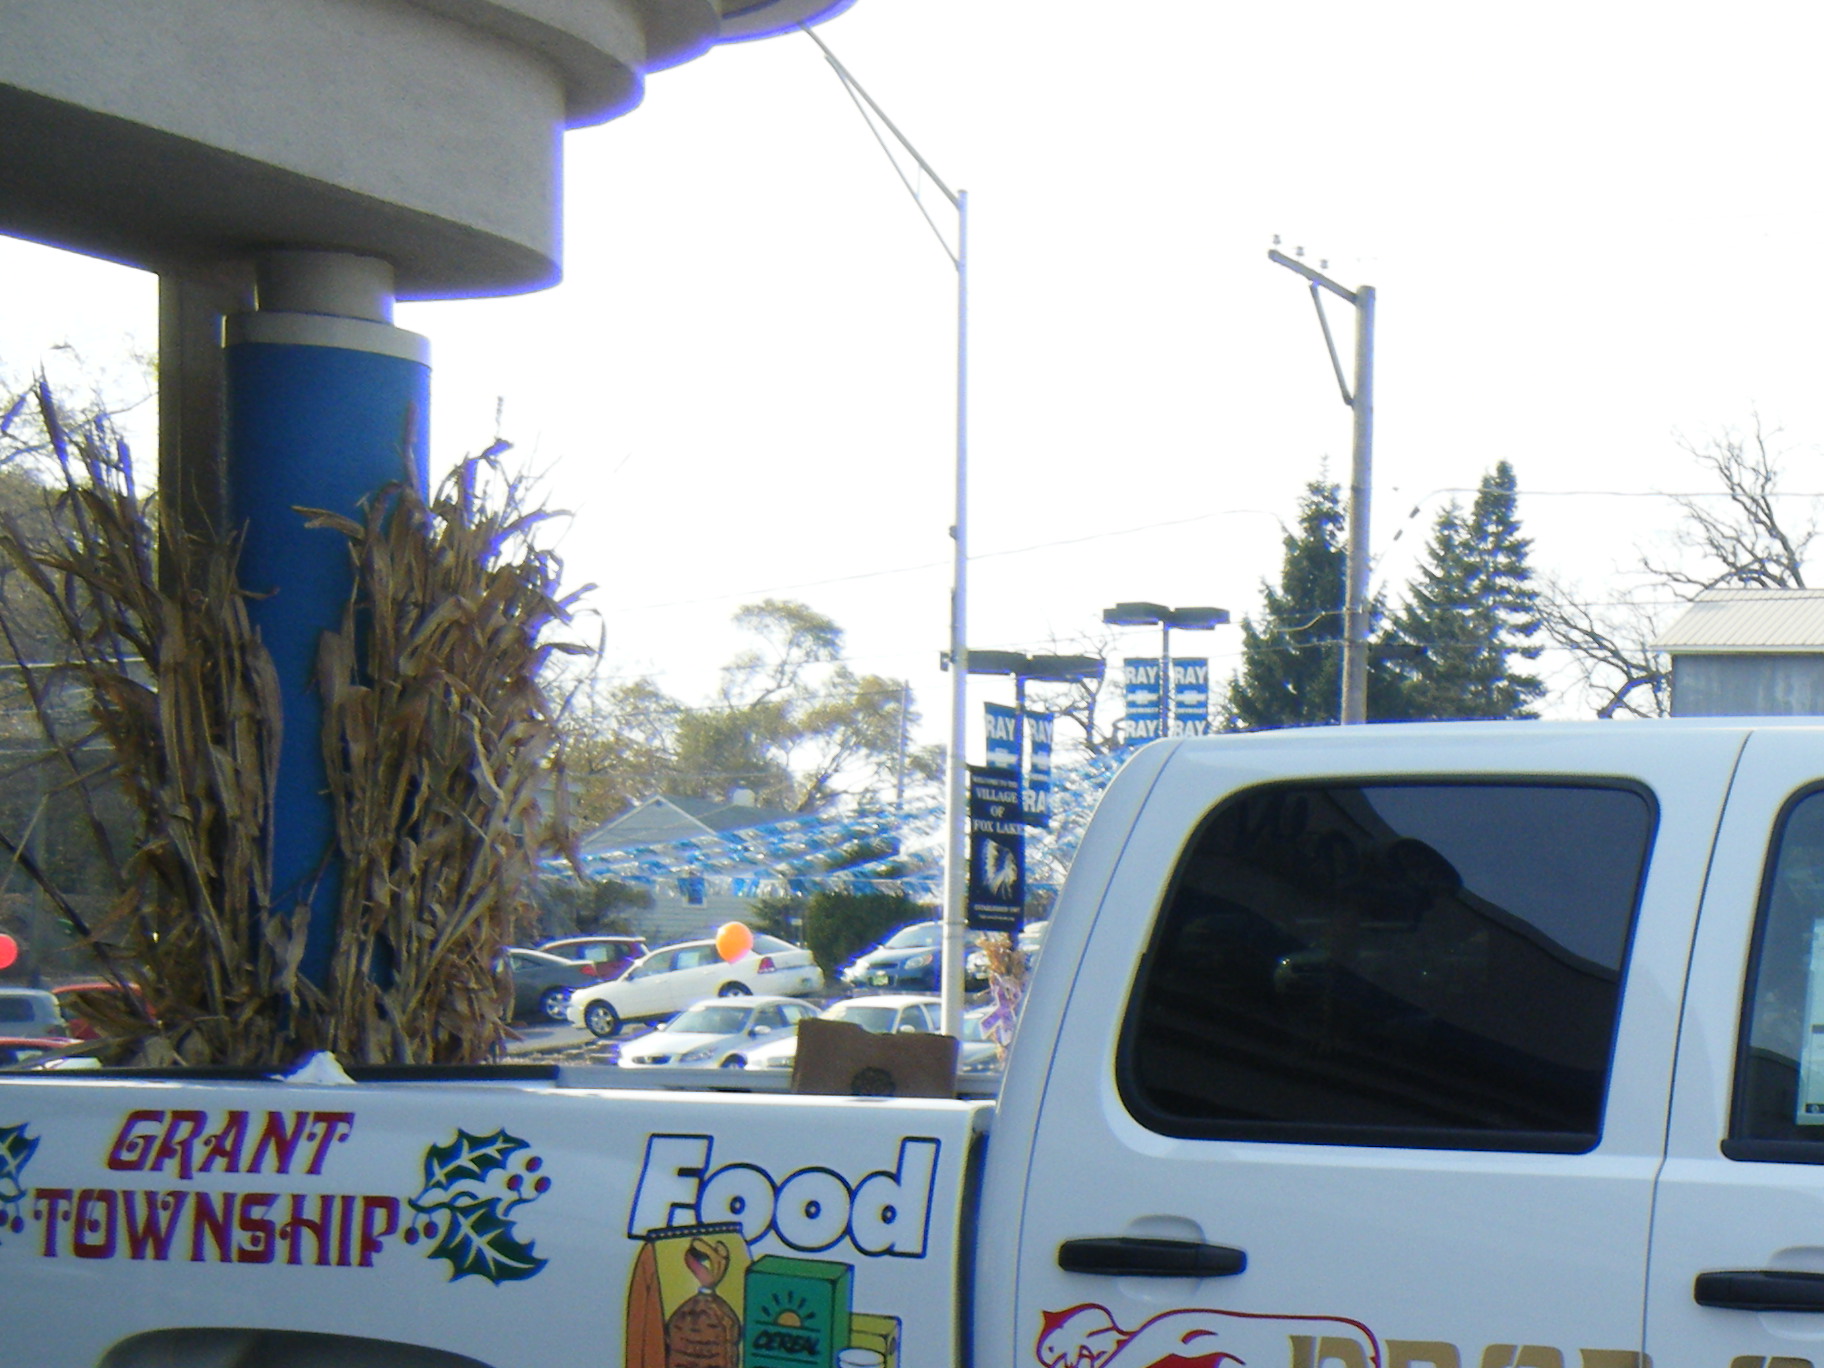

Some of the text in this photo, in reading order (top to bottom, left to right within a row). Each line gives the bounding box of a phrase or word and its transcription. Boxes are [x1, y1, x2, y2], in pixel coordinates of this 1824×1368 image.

[1124, 666, 1158, 685] RAY
[1174, 666, 1207, 685] RAY
[985, 713, 1016, 741] RAY
[1027, 717, 1053, 745] RAY
[1124, 720, 1158, 738] RAY
[1173, 720, 1206, 737] RAY
[975, 787, 1018, 804] VILLAGE
[990, 804, 1006, 818] OF
[973, 819, 994, 833] FOX
[107, 1110, 354, 1180] GRANT
[627, 1134, 941, 1259] Food
[34, 1187, 400, 1268] TOWNSHIP
